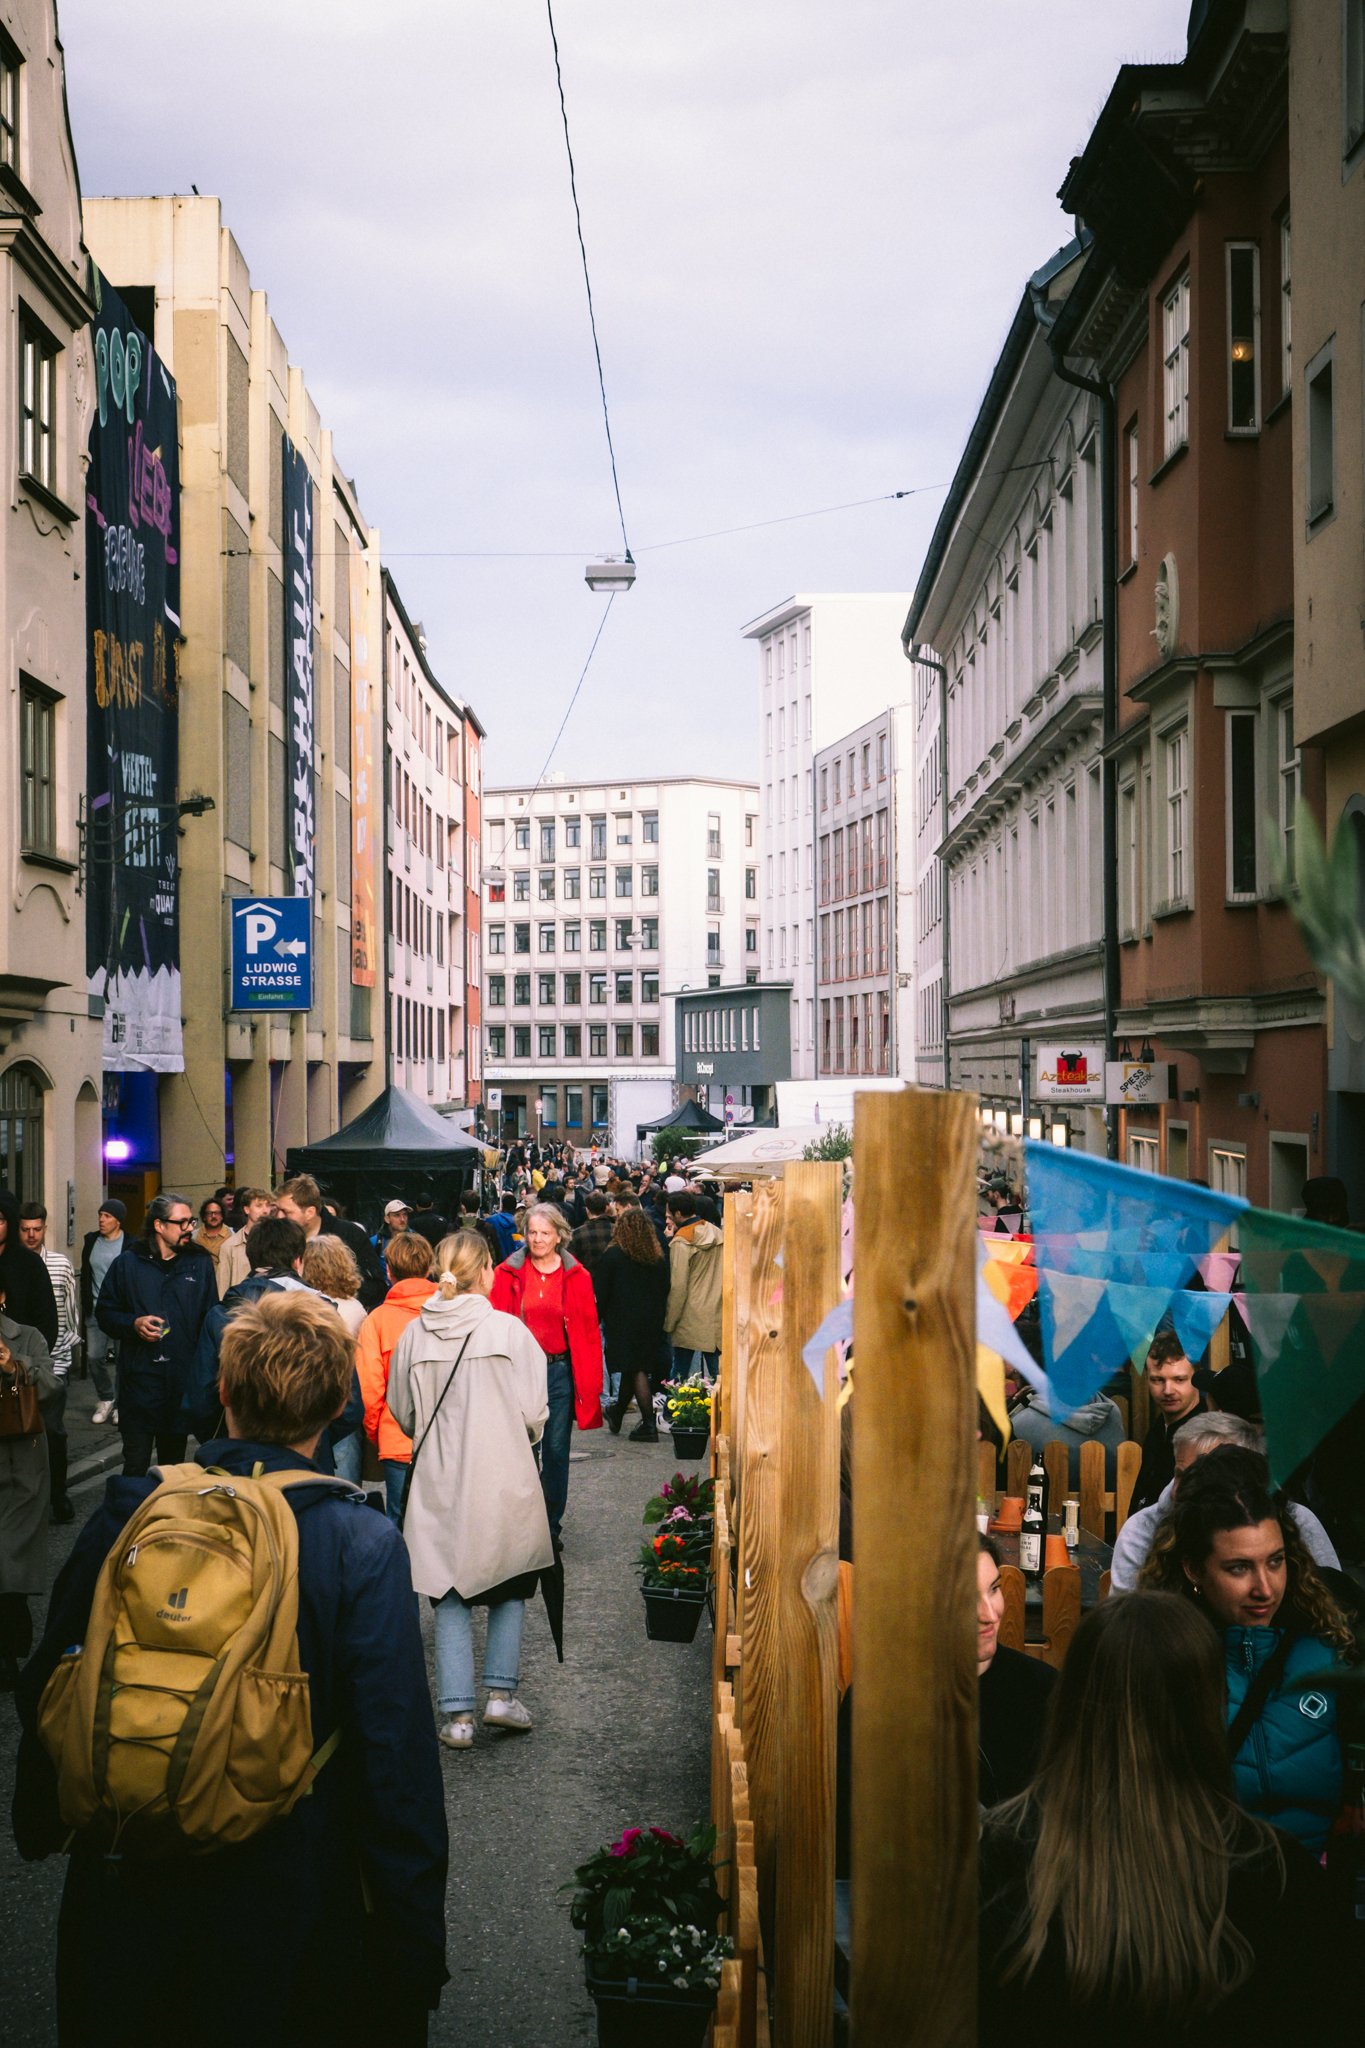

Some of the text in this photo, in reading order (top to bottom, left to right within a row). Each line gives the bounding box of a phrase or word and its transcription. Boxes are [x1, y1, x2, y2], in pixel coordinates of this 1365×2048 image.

[95, 327, 142, 428] POP
[246, 915, 277, 954] P
[246, 963, 297, 973] LUDWIG
[241, 976, 302, 986] STRASSE
[1120, 1069, 1144, 1093] SPIESS
[1133, 1072, 1155, 1092] WERK
[156, 1609, 192, 1622] deuter
